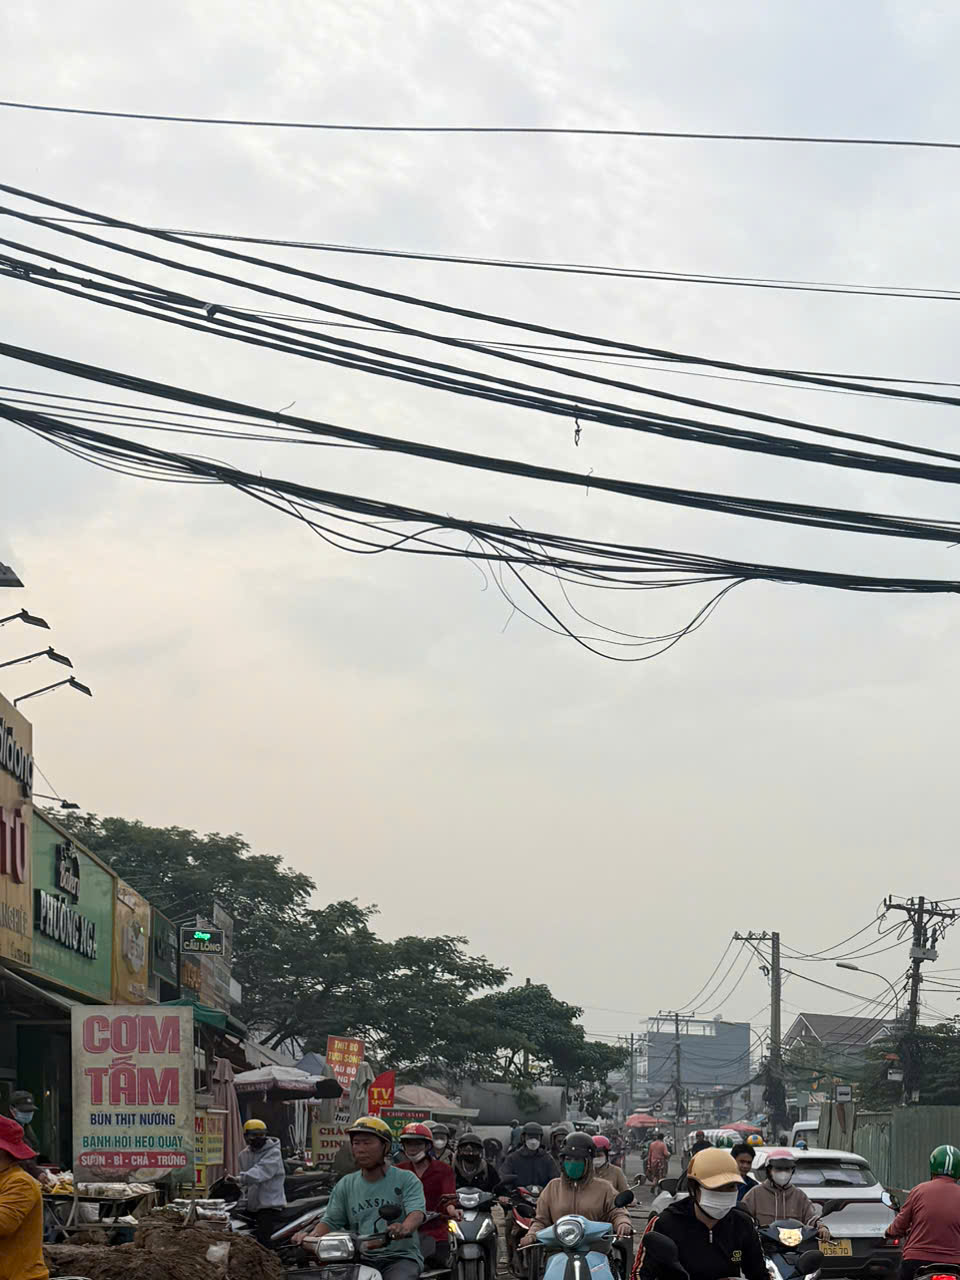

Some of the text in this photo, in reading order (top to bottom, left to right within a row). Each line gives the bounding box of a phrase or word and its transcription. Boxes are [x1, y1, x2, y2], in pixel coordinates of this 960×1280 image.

[83, 1014, 181, 1054] CƠM
[84, 1055, 181, 1106] TẤM
[370, 1087, 392, 1099] TV
[115, 1113, 136, 1128] THỊT
[135, 1136, 155, 1148] HEO
[159, 1136, 184, 1149] QUAY
[113, 1153, 123, 1166] BÌ
